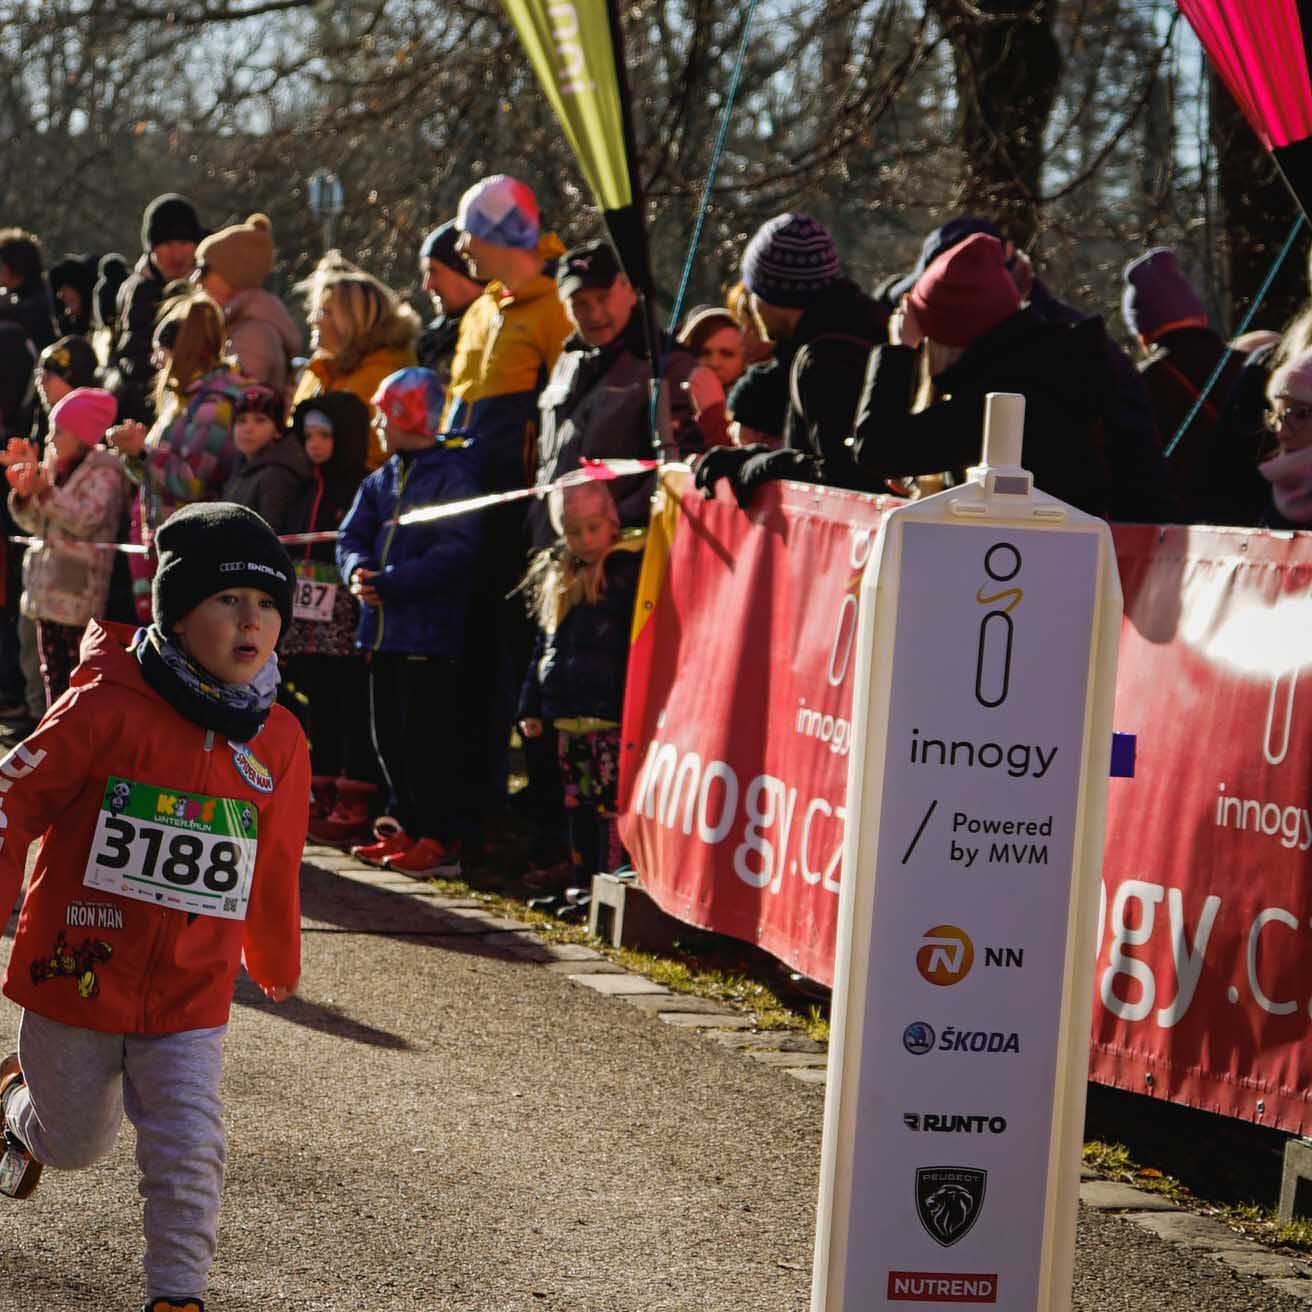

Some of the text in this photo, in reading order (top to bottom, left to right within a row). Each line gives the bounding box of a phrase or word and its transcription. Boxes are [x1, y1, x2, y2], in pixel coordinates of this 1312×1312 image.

[910, 729, 1058, 779] innogy
[953, 813, 1053, 837] Powered
[96, 817, 241, 892] 3188
[950, 840, 1049, 868] by MVM
[66, 905, 123, 928] IRON MAN
[985, 948, 1024, 968] NN
[939, 1026, 1020, 1054] ŠKODA
[923, 1114, 1007, 1134] RUNTO
[923, 1173, 979, 1183] PEUGEOT
[894, 1278, 992, 1296] NUTREND
